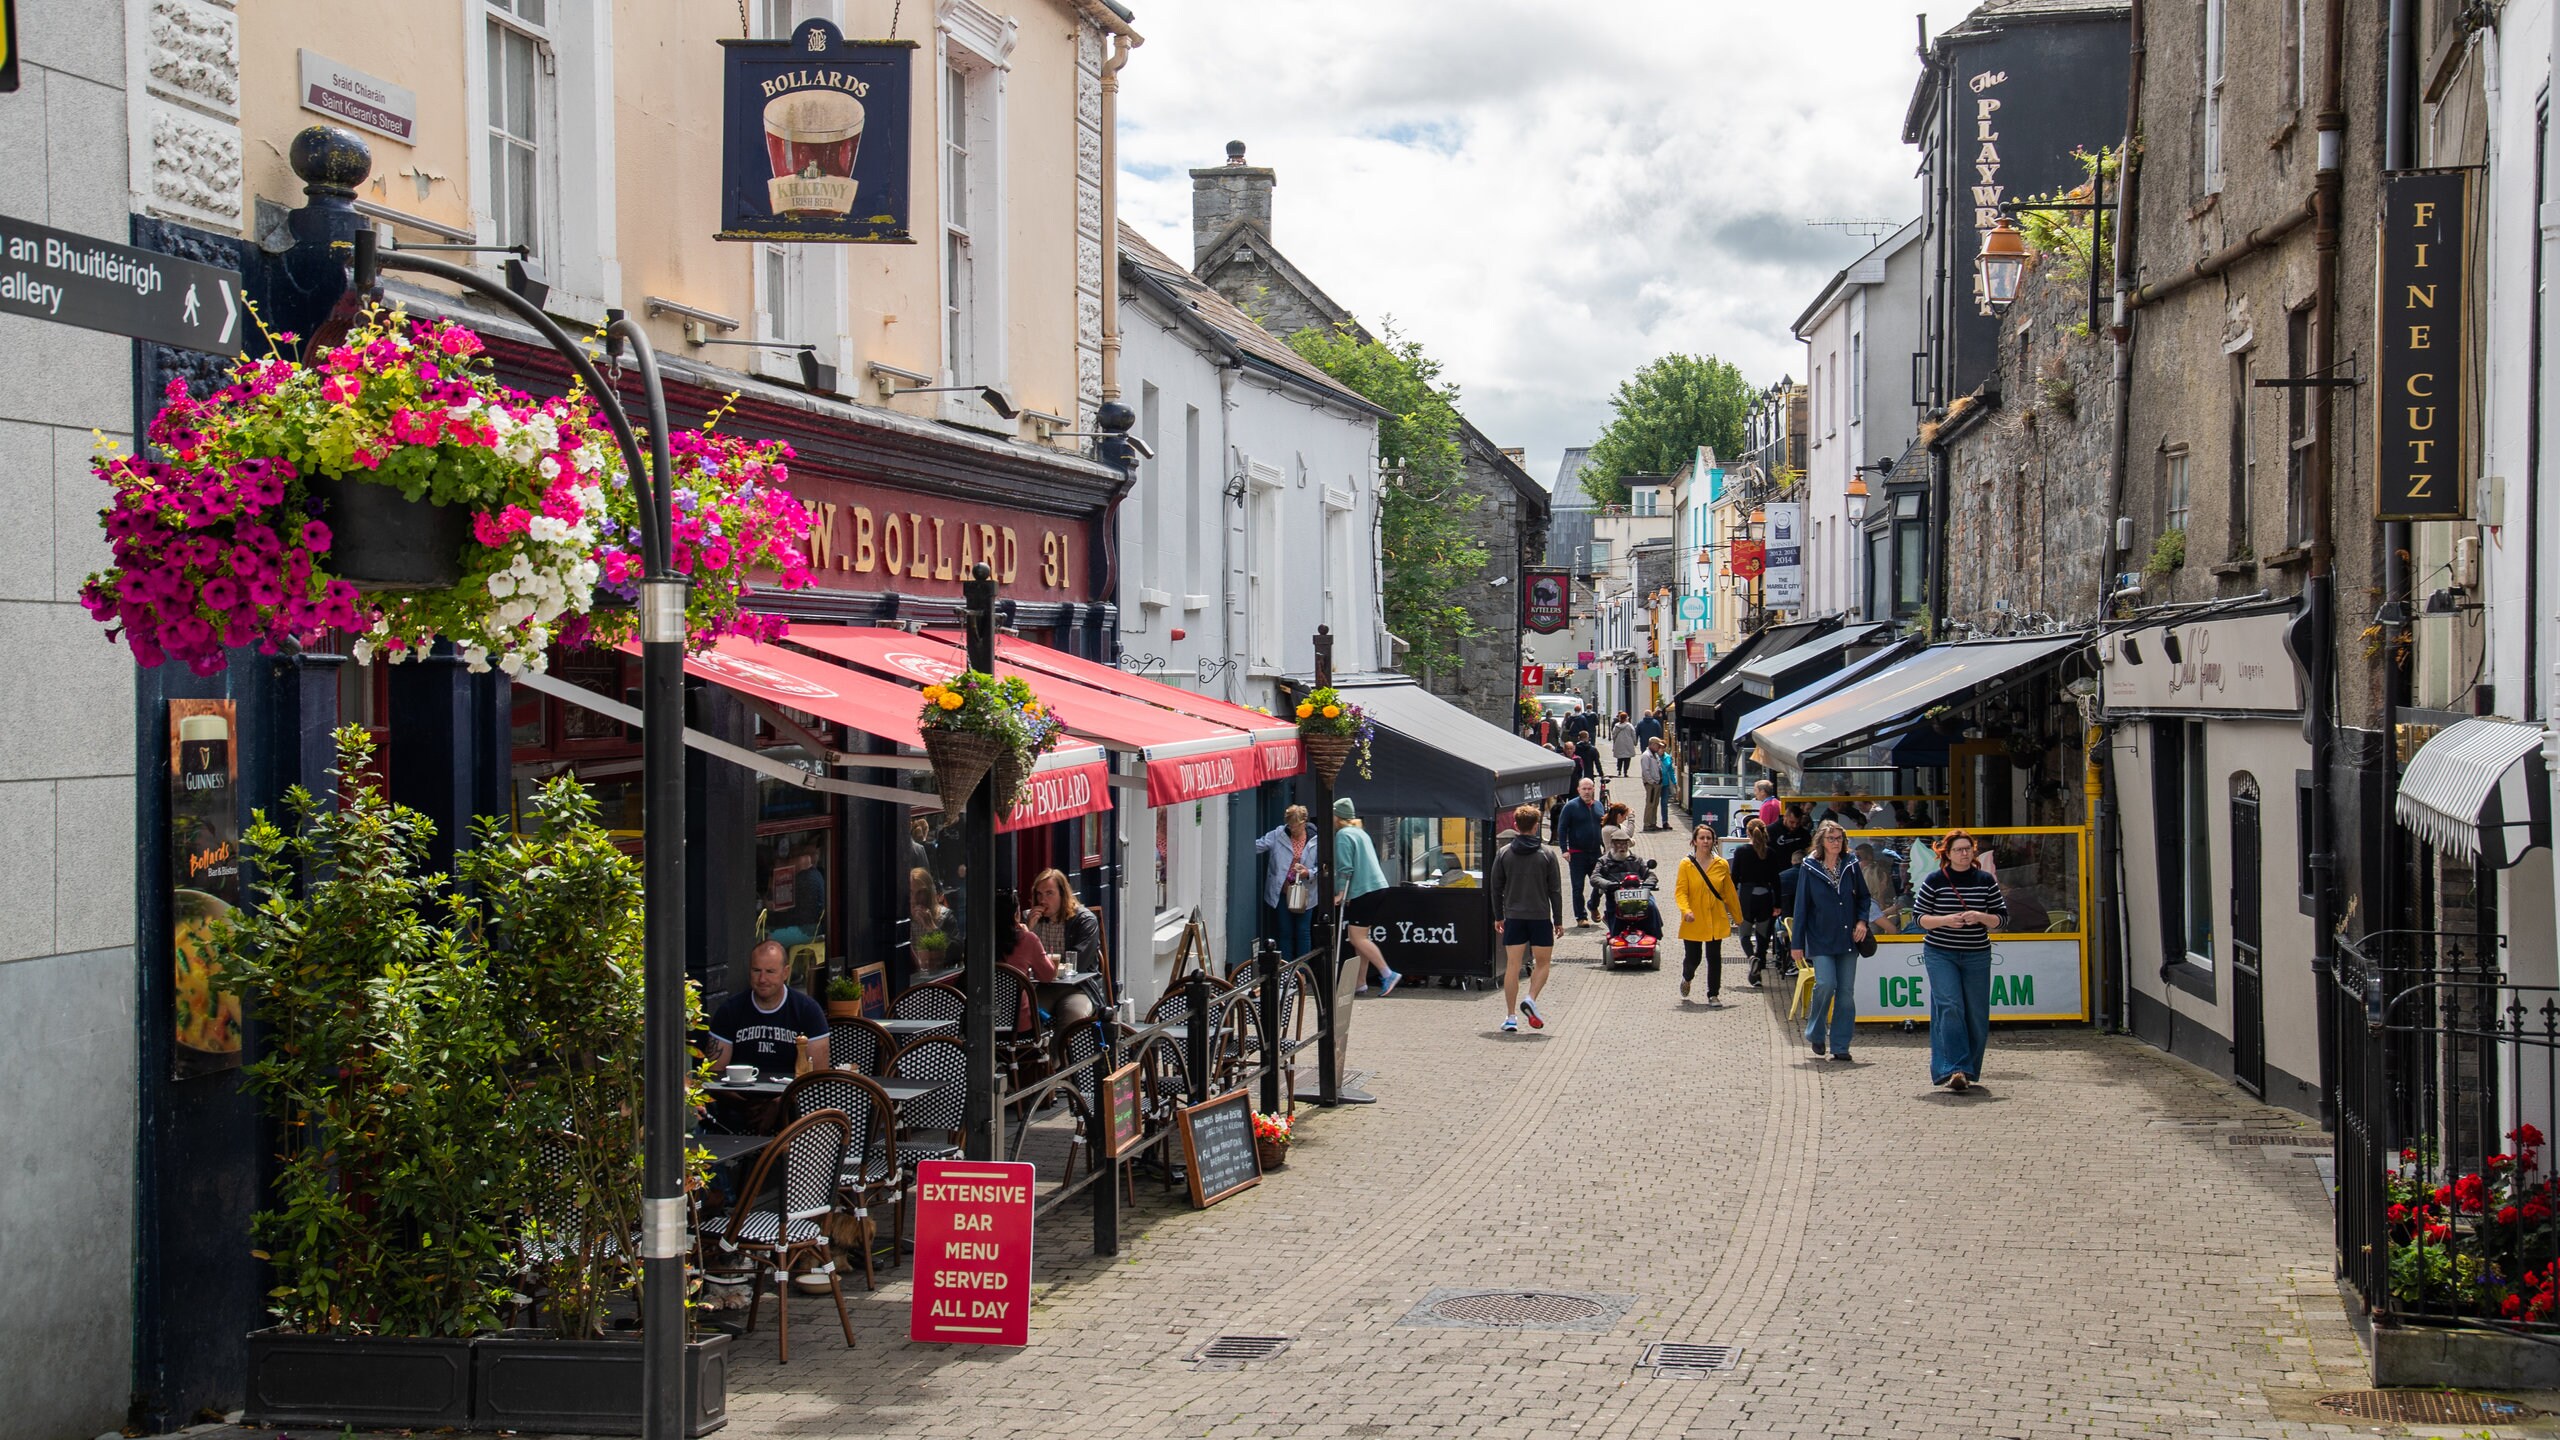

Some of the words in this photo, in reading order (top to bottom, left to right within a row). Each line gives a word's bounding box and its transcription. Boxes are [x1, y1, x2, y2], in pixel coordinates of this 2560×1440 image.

[332, 73, 353, 92] Sráid
[761, 69, 870, 98] BOLLARDS
[1969, 70, 2009, 94] The
[321, 91, 343, 113] Saint
[344, 100, 378, 125] Kieran's
[379, 113, 403, 134] Street
[777, 182, 848, 200] KILKENNY
[814, 197, 833, 208] BEER
[1971, 98, 2004, 317] PLAYWRT
[9, 237, 38, 263] an
[45, 237, 162, 296] Bhuitléirigh
[2406, 202, 2438, 350] FINE
[0, 270, 63, 315] allery
[2405, 372, 2436, 499] CUTZ
[1041, 530, 1069, 588] 31
[1775, 556, 1793, 565] 2014
[1530, 606, 1562, 614] KYTELERS
[186, 771, 225, 791] GUINNESS
[1179, 763, 1195, 793] DW
[1195, 757, 1235, 791] BOLLARD
[1036, 773, 1091, 816] BOLLARD
[1619, 890, 1643, 900] FECKIT
[1396, 921, 1458, 944] Yard
[1880, 976, 1924, 1007] ICE
[735, 1025, 773, 1044] SCHOTT
[757, 1041, 777, 1054] INC.
[922, 1183, 1027, 1204] EXTENSIVE
[953, 1213, 993, 1232] BAR
[945, 1242, 999, 1261] MENU
[933, 1270, 1008, 1290] SERVED
[929, 1299, 967, 1317] ALL
[971, 1300, 1009, 1319] DAY
